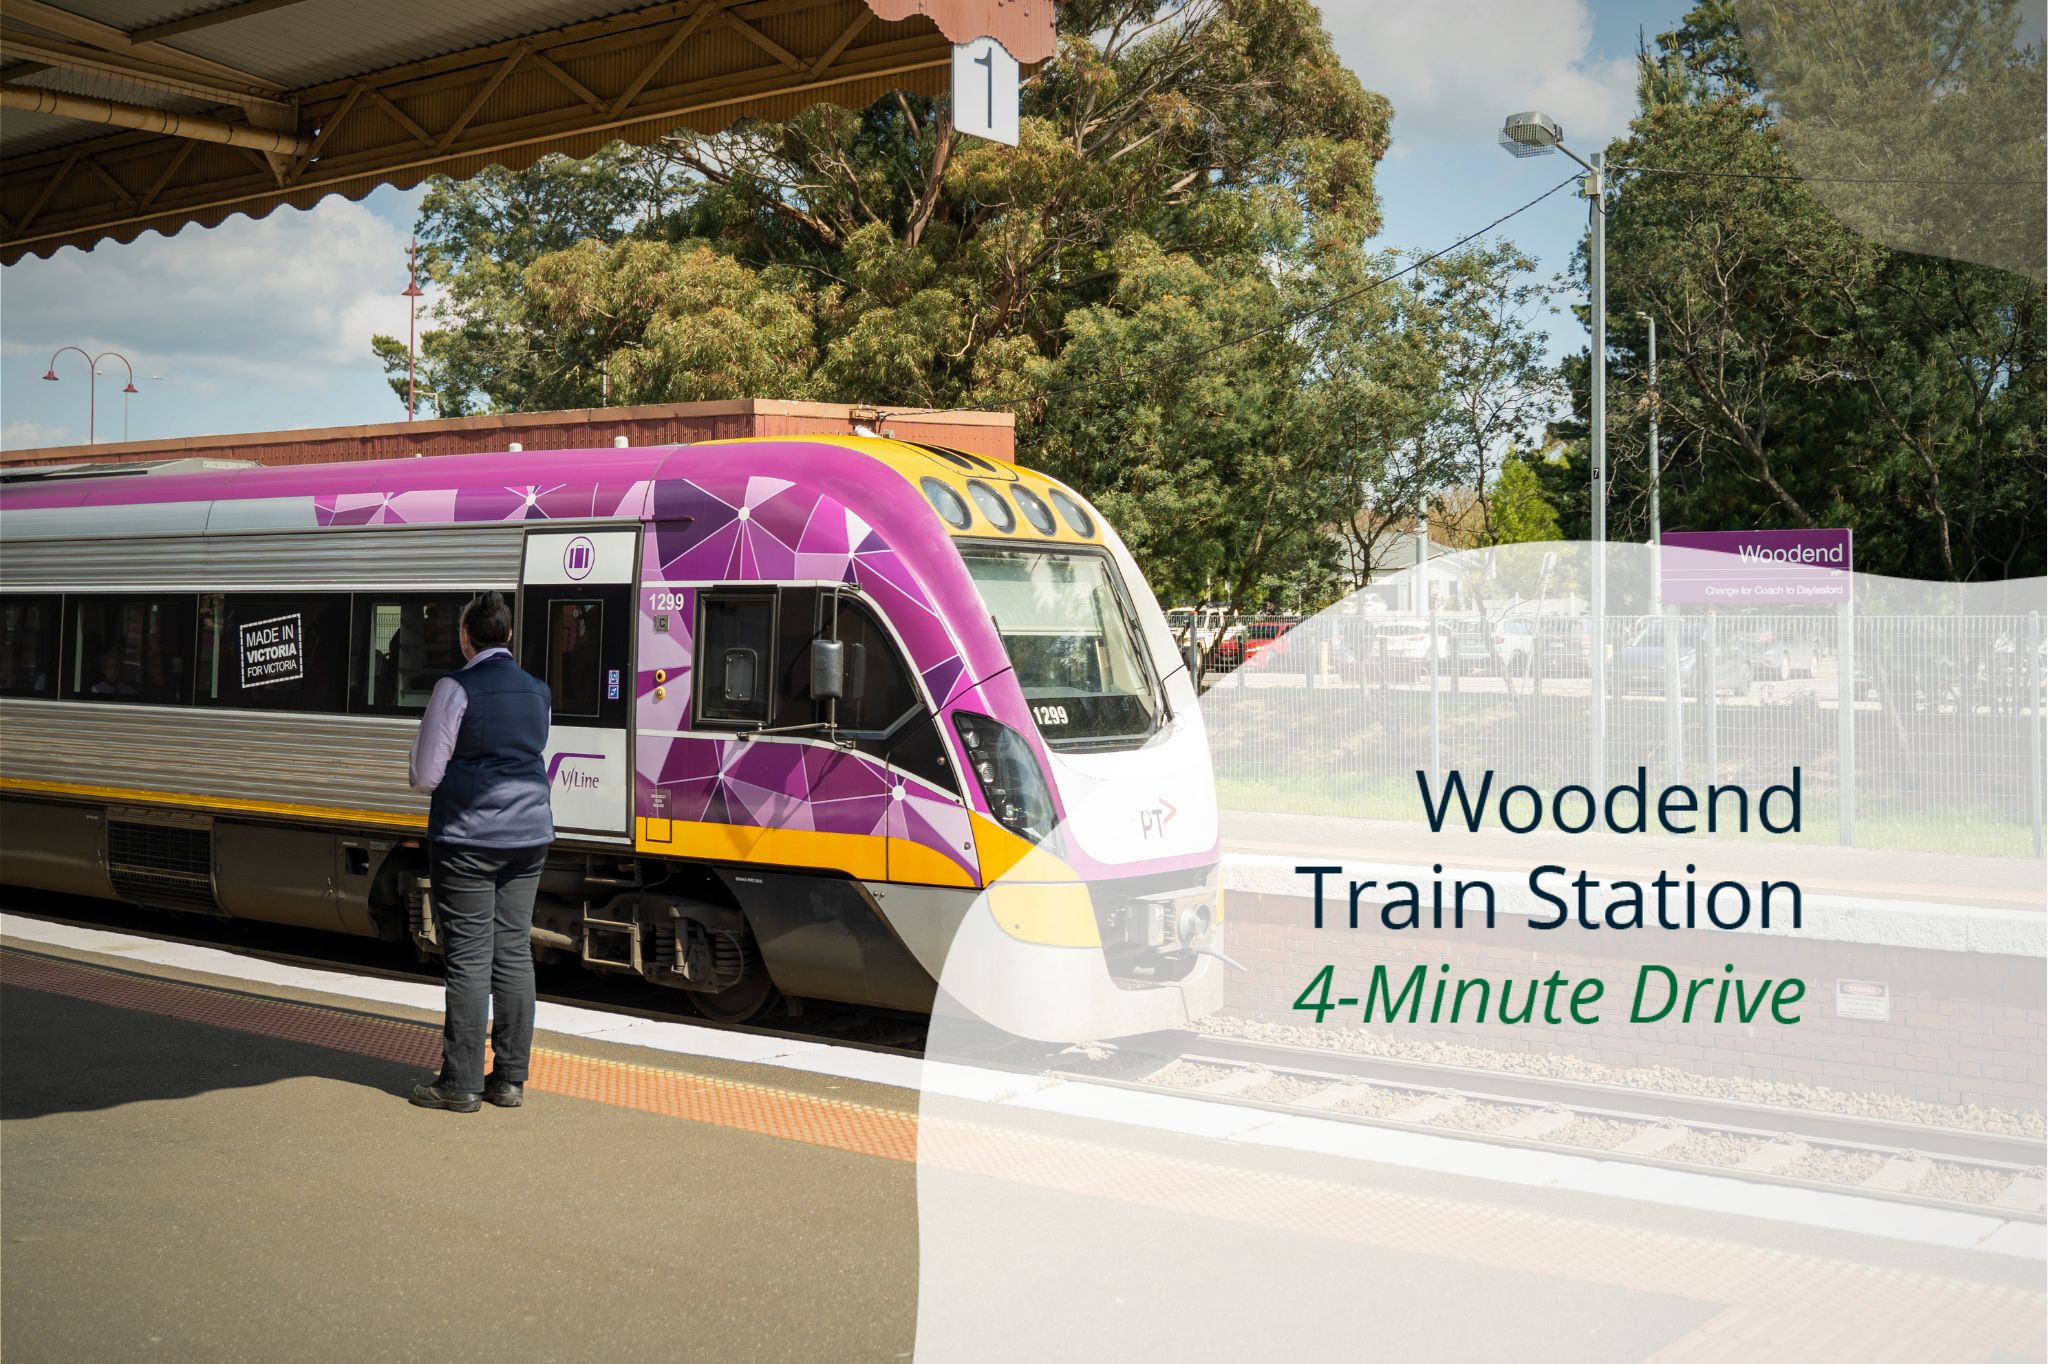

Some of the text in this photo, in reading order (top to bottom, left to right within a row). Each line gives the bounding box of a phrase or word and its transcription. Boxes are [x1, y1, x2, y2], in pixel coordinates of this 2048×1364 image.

[974, 46, 992, 129] 1
[1593, 468, 1599, 478] 7
[1738, 543, 1843, 563] Woodend
[1705, 584, 1844, 596] Change for Coach to Daylesford
[649, 593, 685, 611] 1299
[246, 623, 294, 648] MADE IN
[246, 642, 298, 664] VICTORIA
[247, 659, 297, 678] FOR VICTORIA
[1033, 705, 1069, 725] 1299
